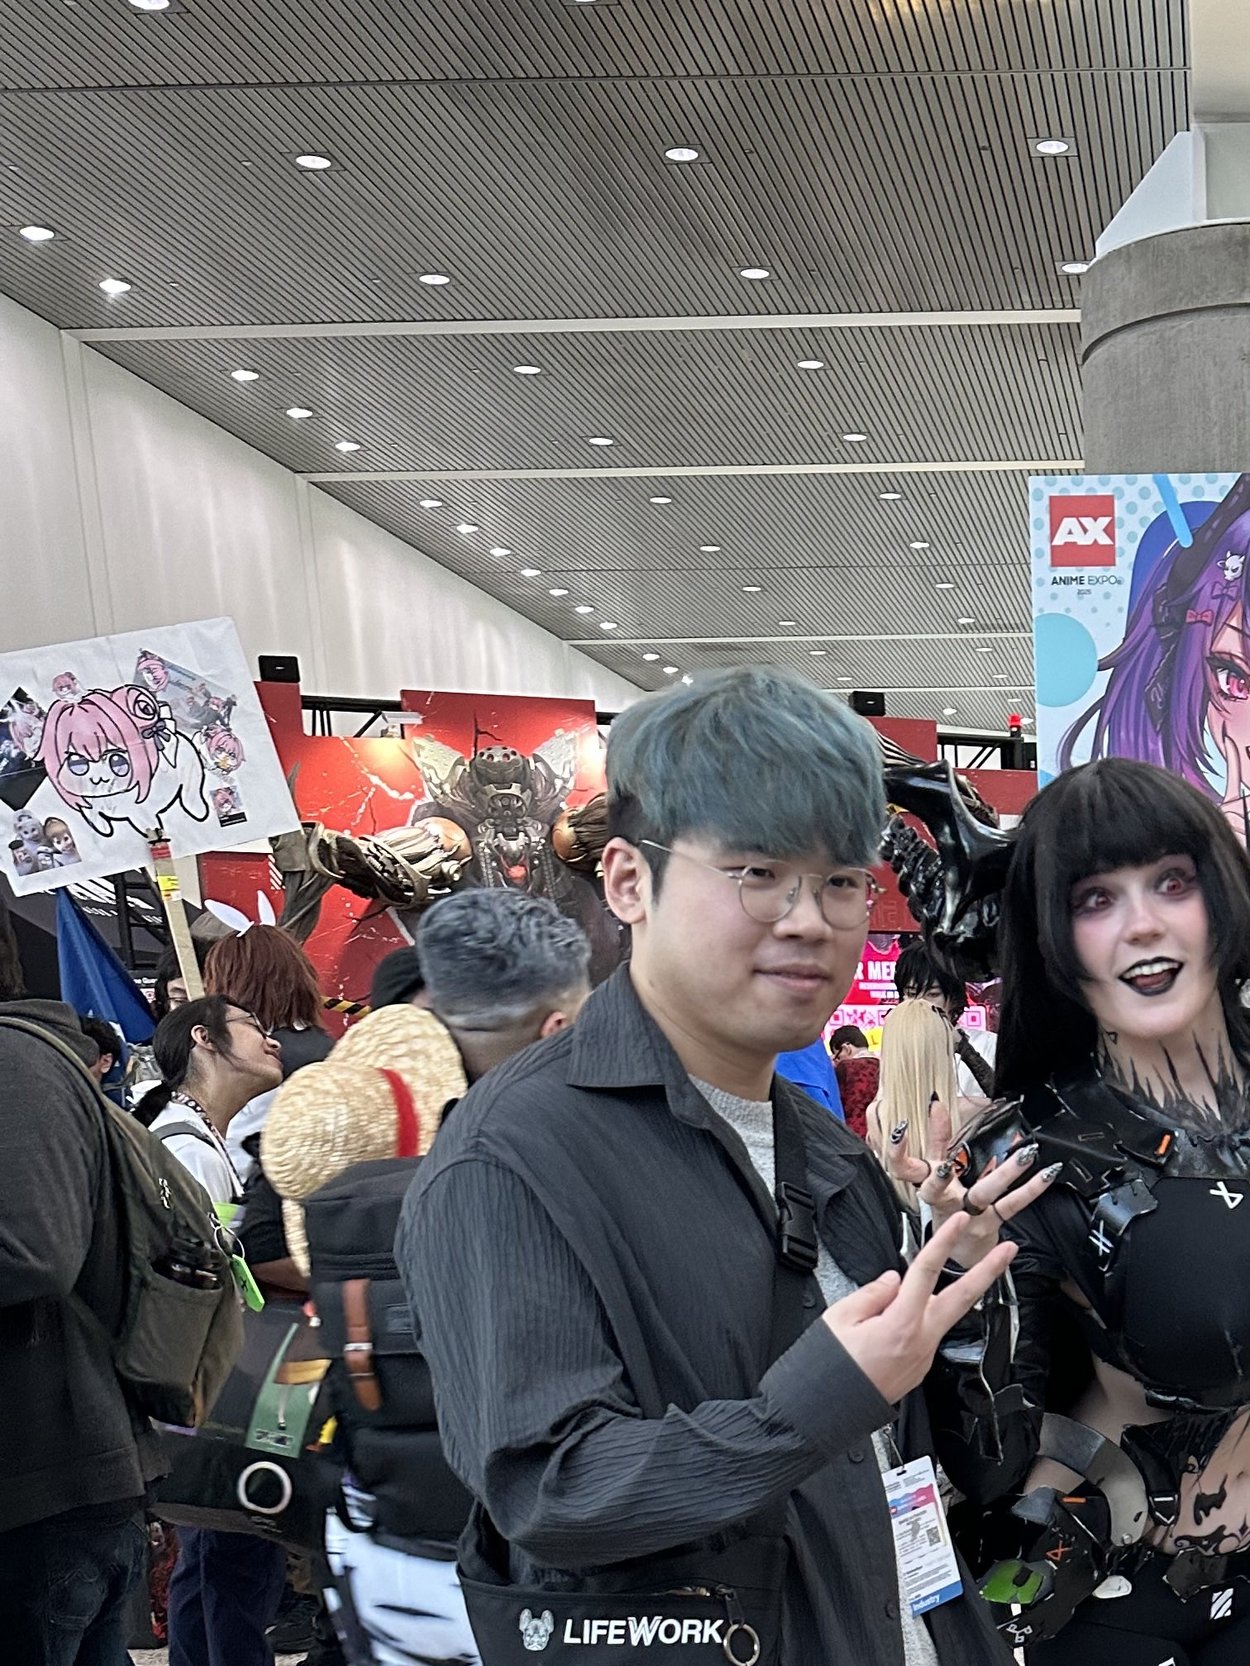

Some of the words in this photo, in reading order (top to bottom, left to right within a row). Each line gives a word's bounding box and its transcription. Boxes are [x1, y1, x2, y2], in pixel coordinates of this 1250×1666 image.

[1051, 516, 1114, 545] AX
[1051, 576, 1085, 586] ANIME
[912, 1594, 940, 1612] Industry
[563, 1616, 724, 1646] LIFEWORK
